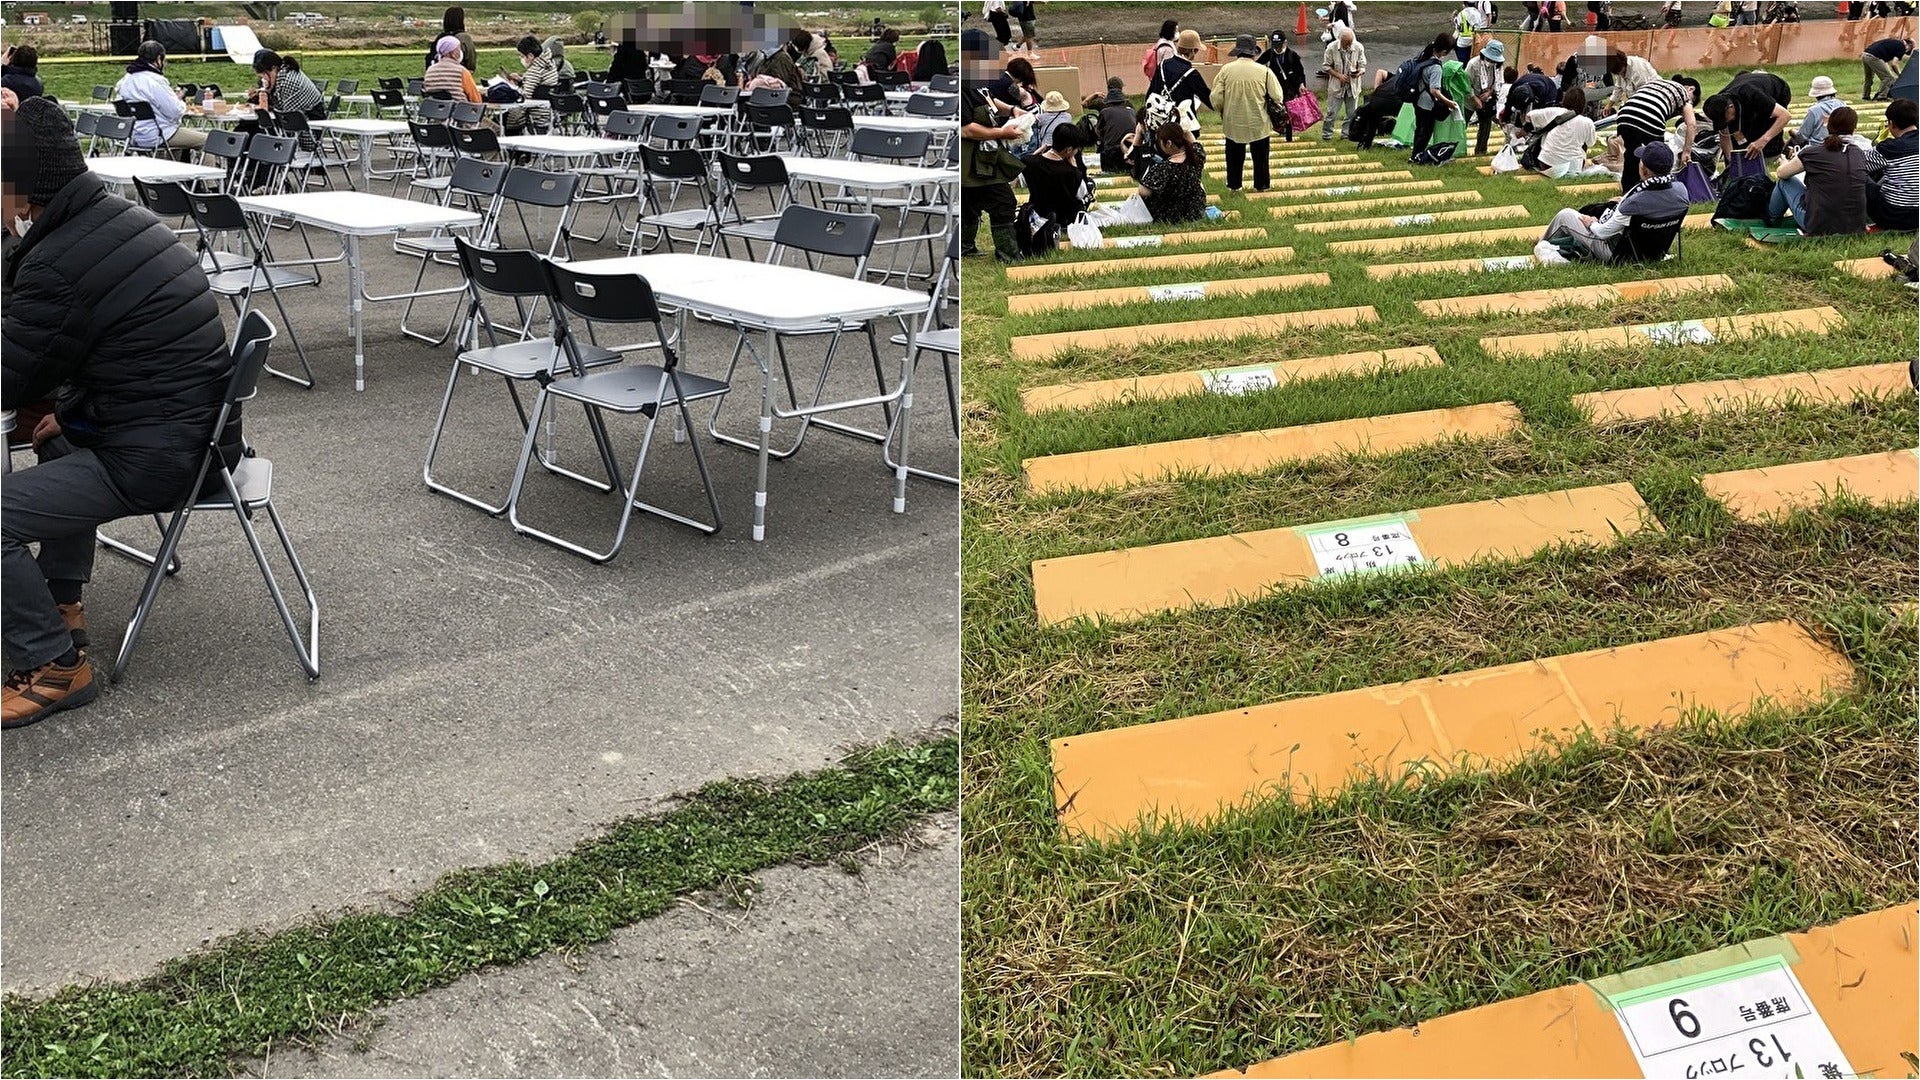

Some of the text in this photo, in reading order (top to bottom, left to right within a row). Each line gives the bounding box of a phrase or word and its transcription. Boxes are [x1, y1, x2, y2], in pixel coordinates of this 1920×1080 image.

[1334, 532, 1350, 547] 8
[1372, 544, 1394, 557] 13
[1668, 995, 1792, 1038] 席番号 9
[1686, 1033, 1792, 1079] 13 ブロック
